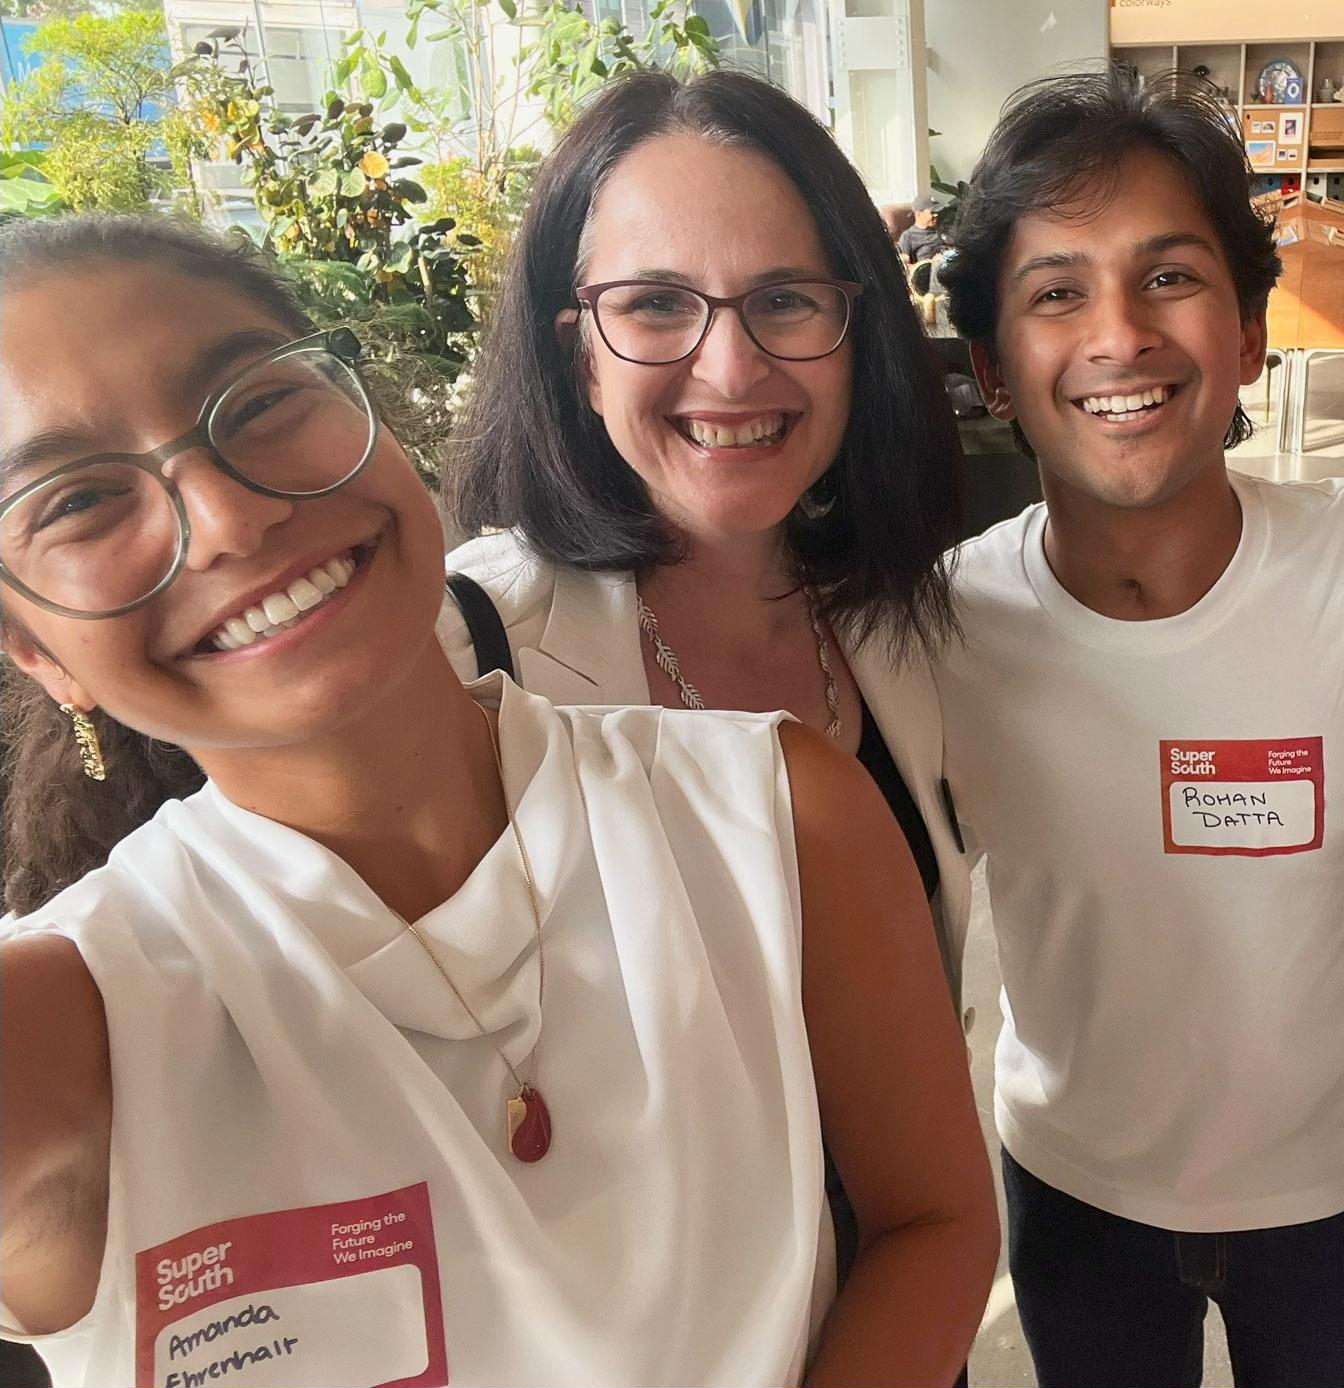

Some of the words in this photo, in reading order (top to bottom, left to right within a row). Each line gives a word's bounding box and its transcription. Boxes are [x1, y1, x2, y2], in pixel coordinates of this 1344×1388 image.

[1170, 748, 1215, 763] Super
[1268, 750, 1295, 760] Forging
[1295, 749, 1309, 757] the
[1268, 758, 1292, 767] Future
[1171, 761, 1216, 775] South
[1282, 766, 1312, 775] Imagine
[1182, 786, 1267, 807] ROHAN
[1192, 811, 1284, 828] DATTA
[331, 1219, 382, 1236] Forging
[383, 1213, 406, 1226] the
[332, 1235, 375, 1250] Future
[333, 1252, 356, 1264] We
[358, 1240, 413, 1260] Imagine
[157, 1241, 232, 1285] Super
[158, 1263, 233, 1310] South
[169, 1304, 280, 1360] Amanda
